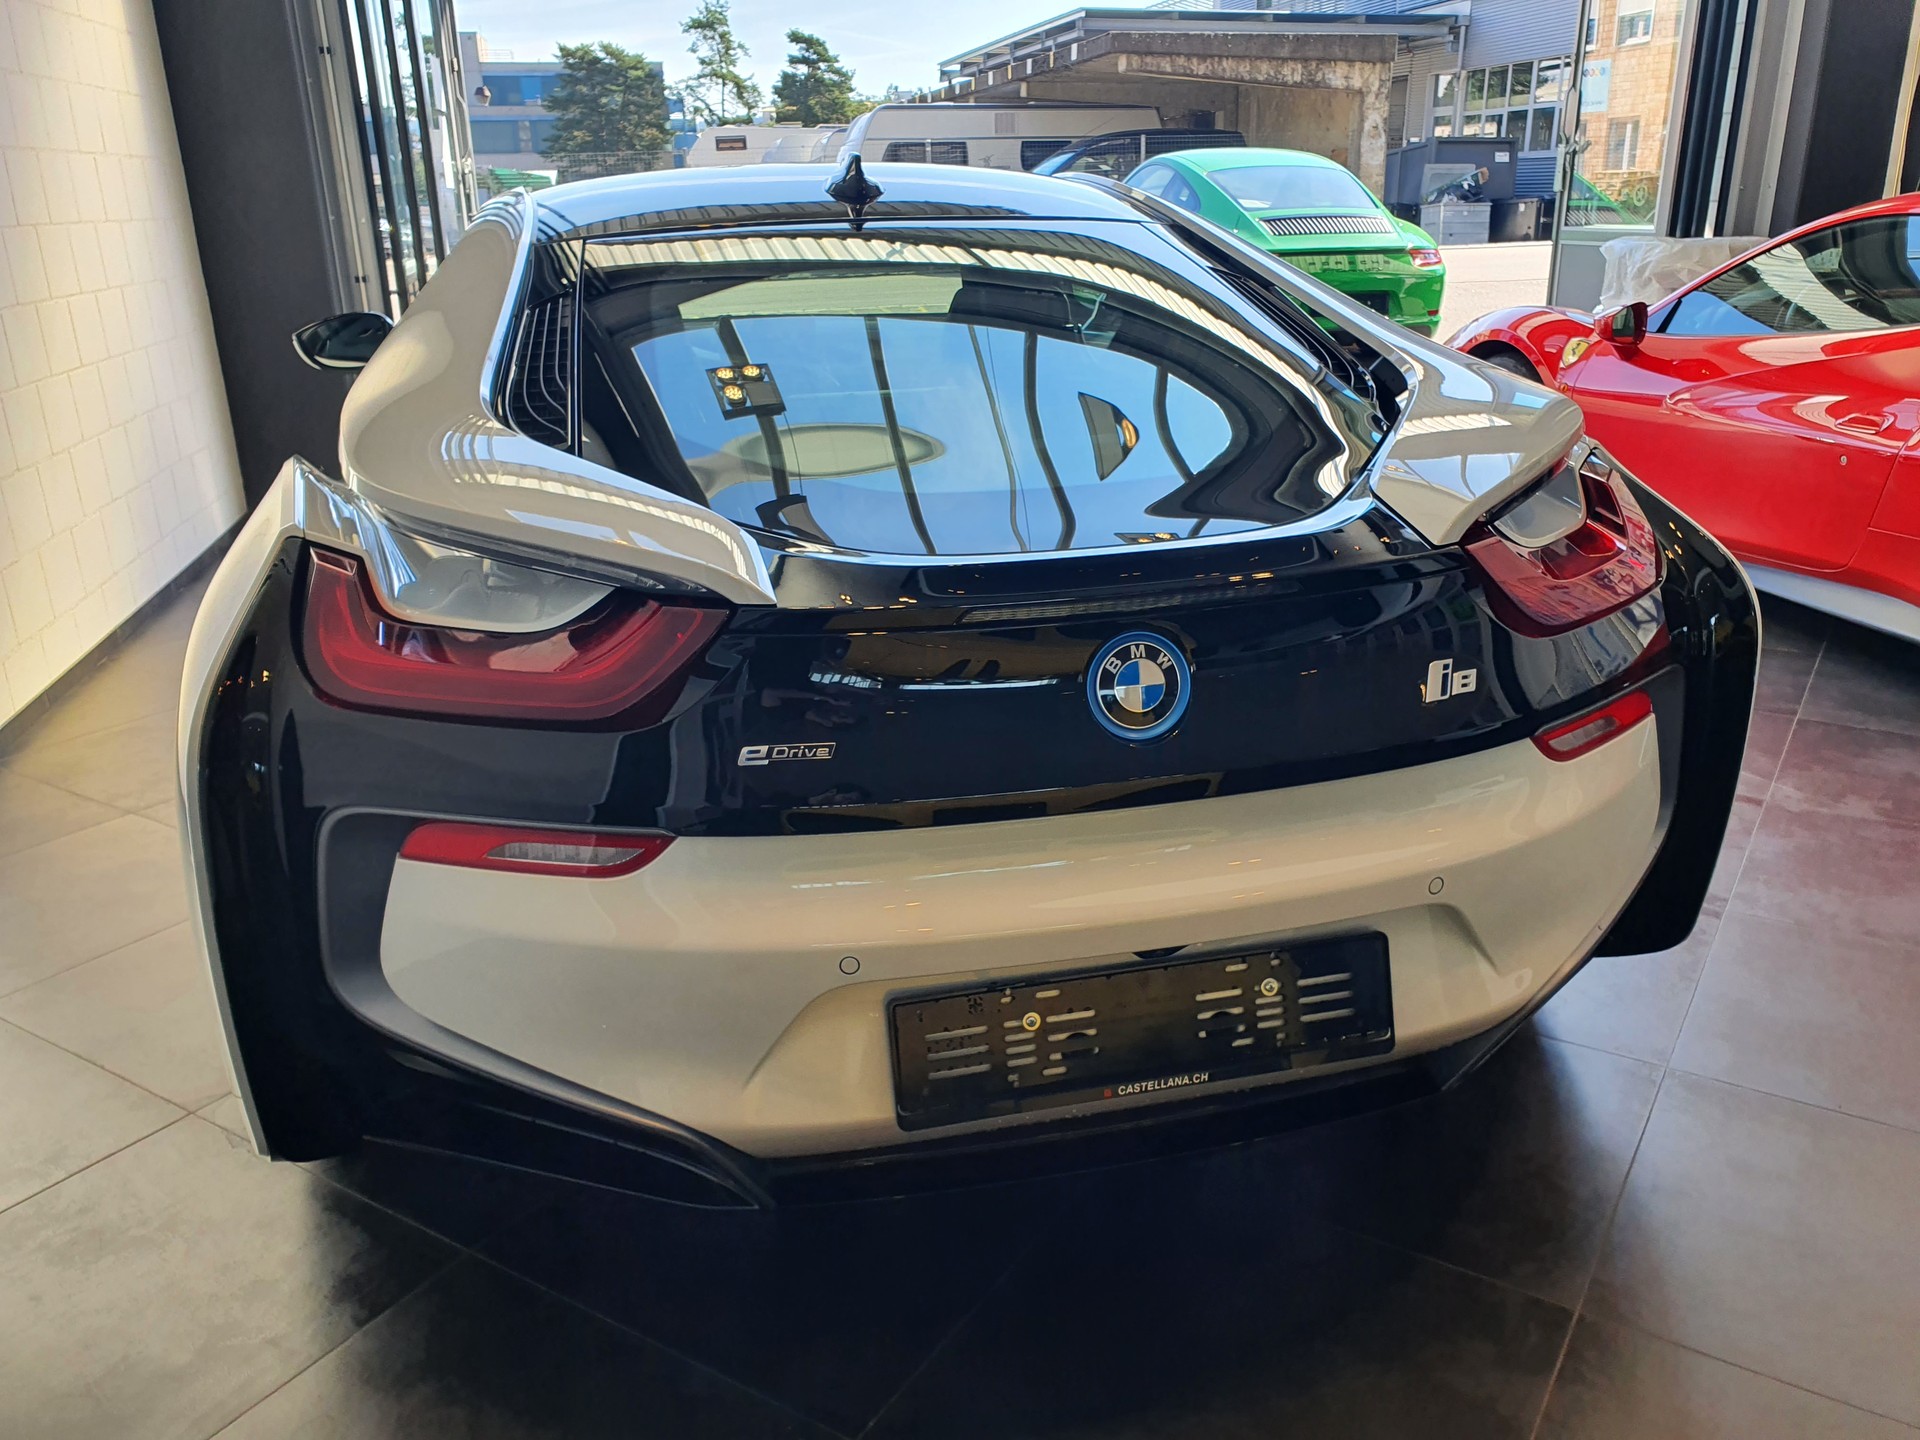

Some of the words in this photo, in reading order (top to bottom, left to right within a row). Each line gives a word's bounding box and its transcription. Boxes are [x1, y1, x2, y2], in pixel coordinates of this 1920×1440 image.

[1105, 644, 1172, 674] BMW
[1426, 658, 1477, 703] i8
[1118, 1072, 1209, 1095] CASTELLANA.CH
